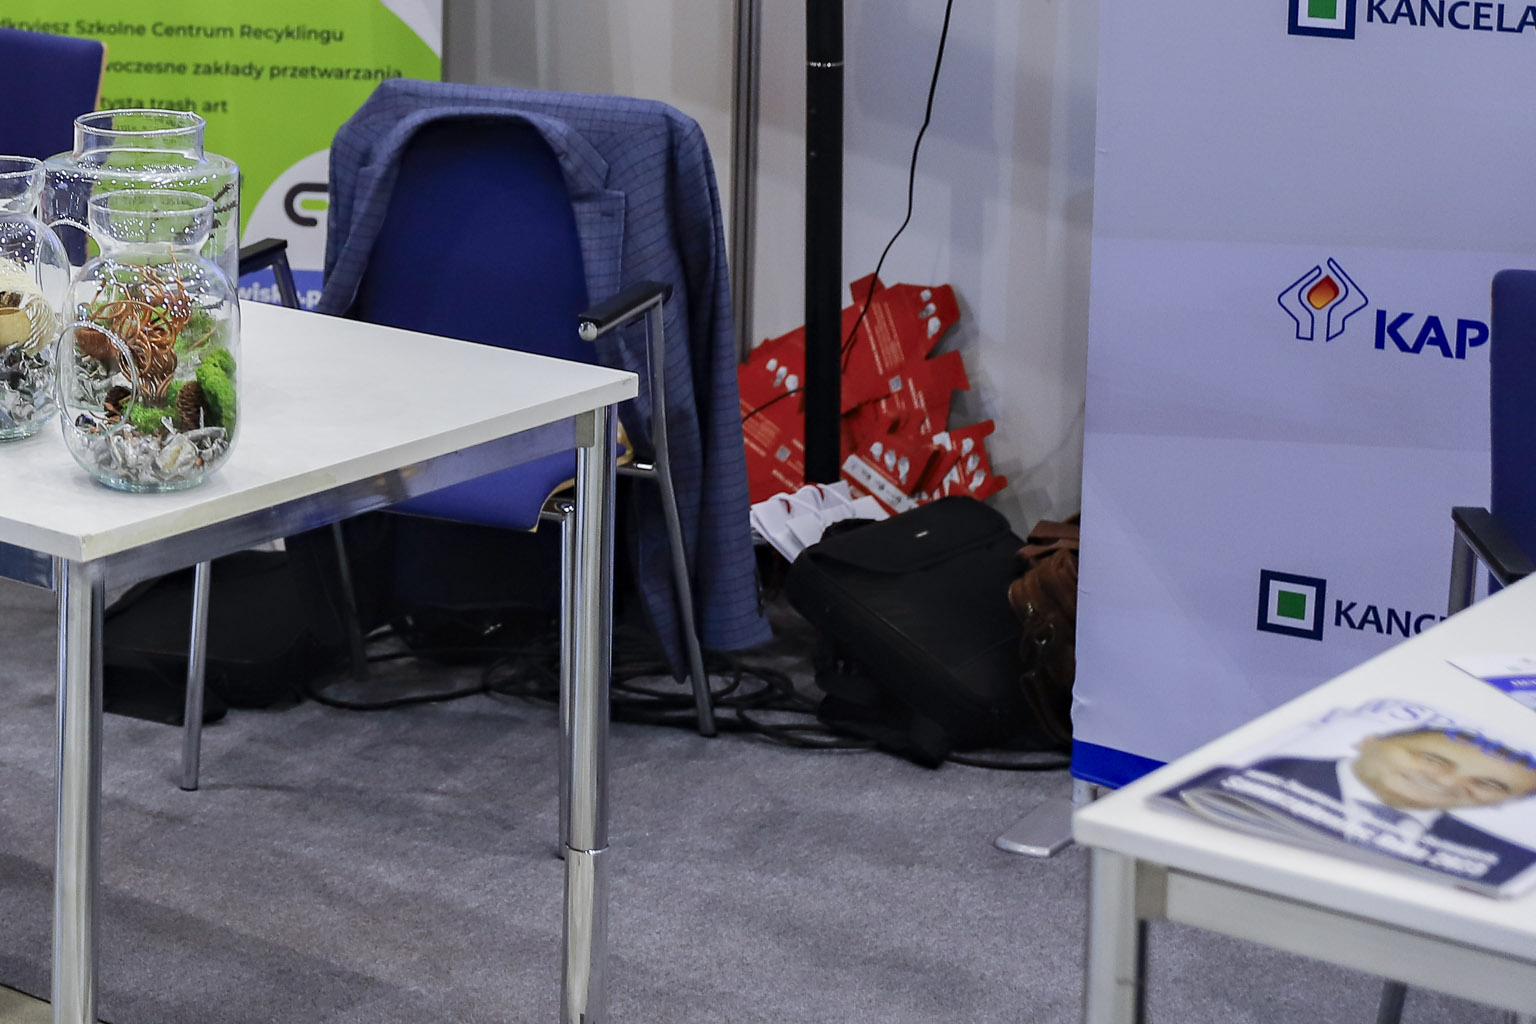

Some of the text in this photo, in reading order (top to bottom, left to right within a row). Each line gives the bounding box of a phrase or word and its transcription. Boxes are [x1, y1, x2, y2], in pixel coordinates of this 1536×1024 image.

[76, 20, 146, 37] Szkolne
[152, 22, 234, 40] Centrum
[239, 24, 344, 44] Recyklingu
[193, 59, 262, 80] zakłady
[269, 64, 402, 82] przetwarzania
[202, 100, 228, 114] art
[1374, 309, 1489, 360] KAP
